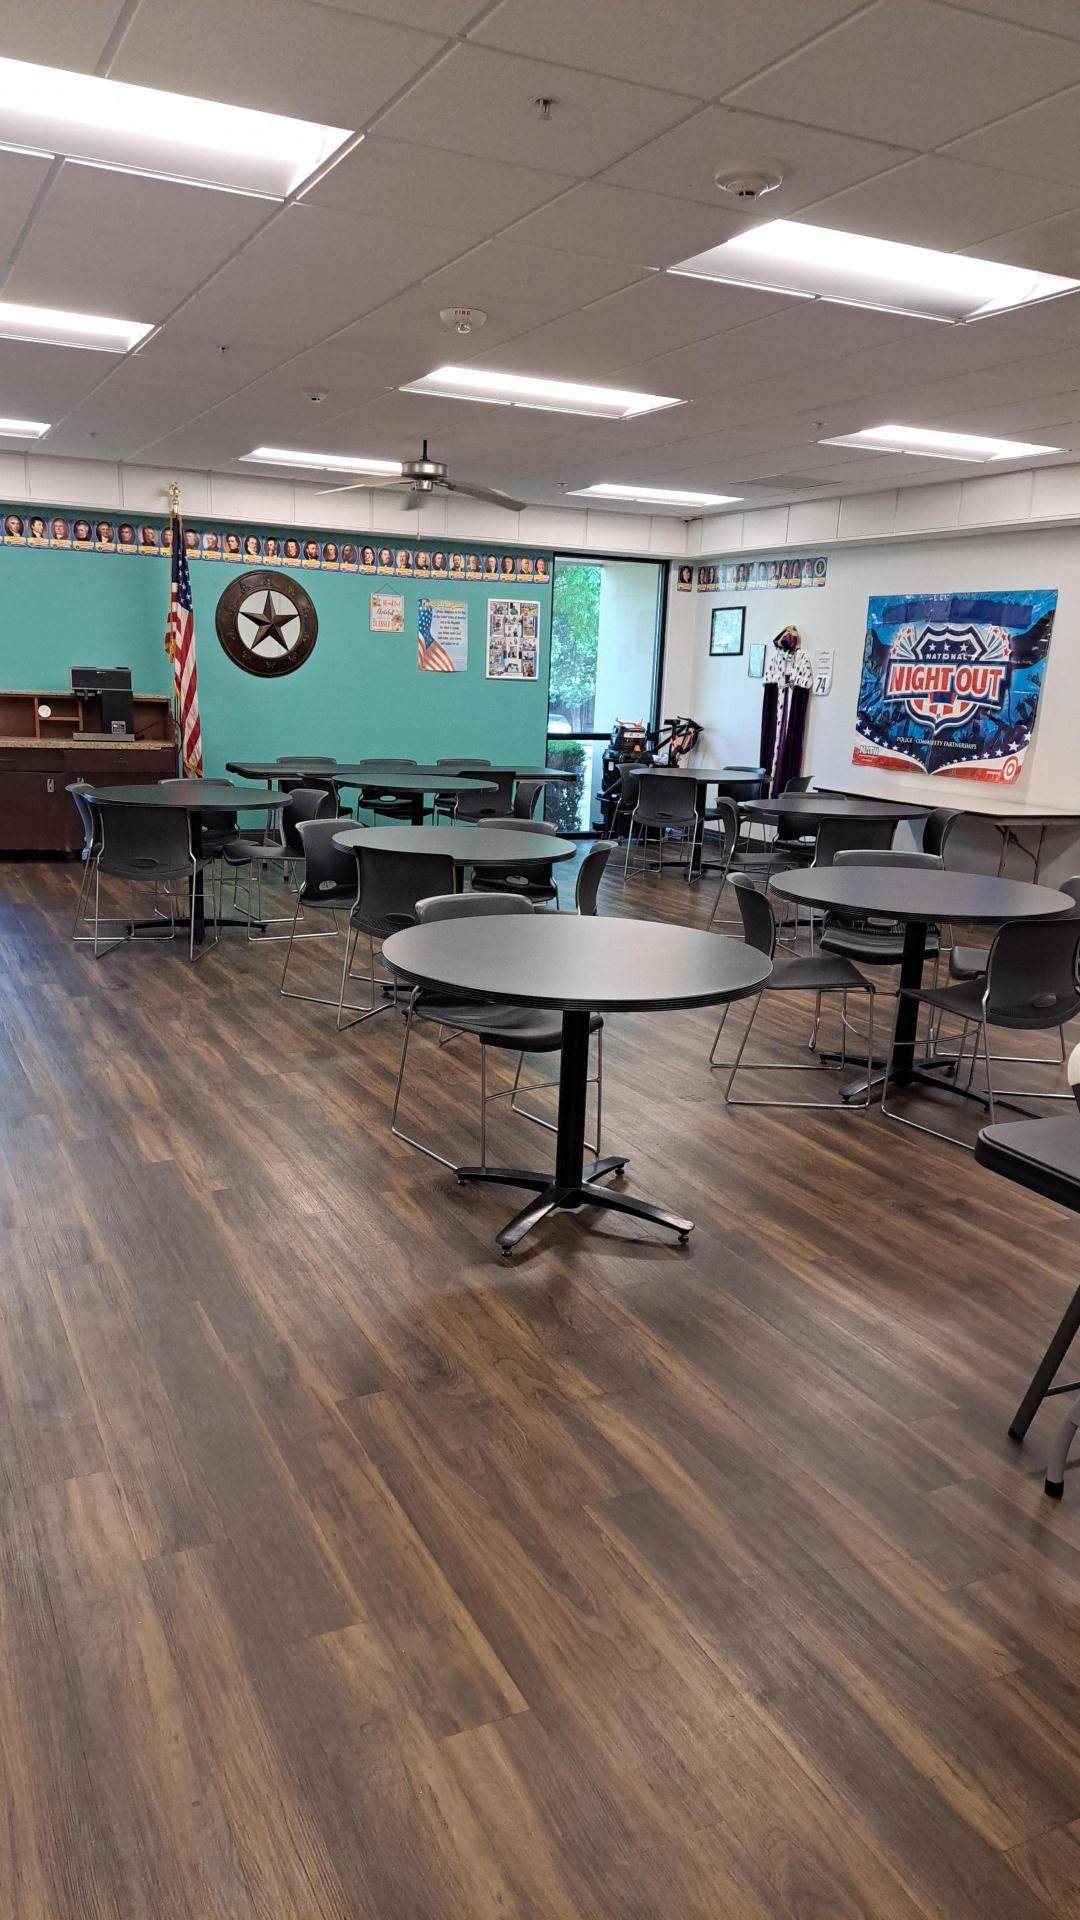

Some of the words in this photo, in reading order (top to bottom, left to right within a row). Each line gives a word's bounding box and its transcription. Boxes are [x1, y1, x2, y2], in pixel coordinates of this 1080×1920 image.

[815, 677, 827, 693] 74
[889, 663, 953, 695] NIGHT
[955, 665, 1005, 700] OUT
